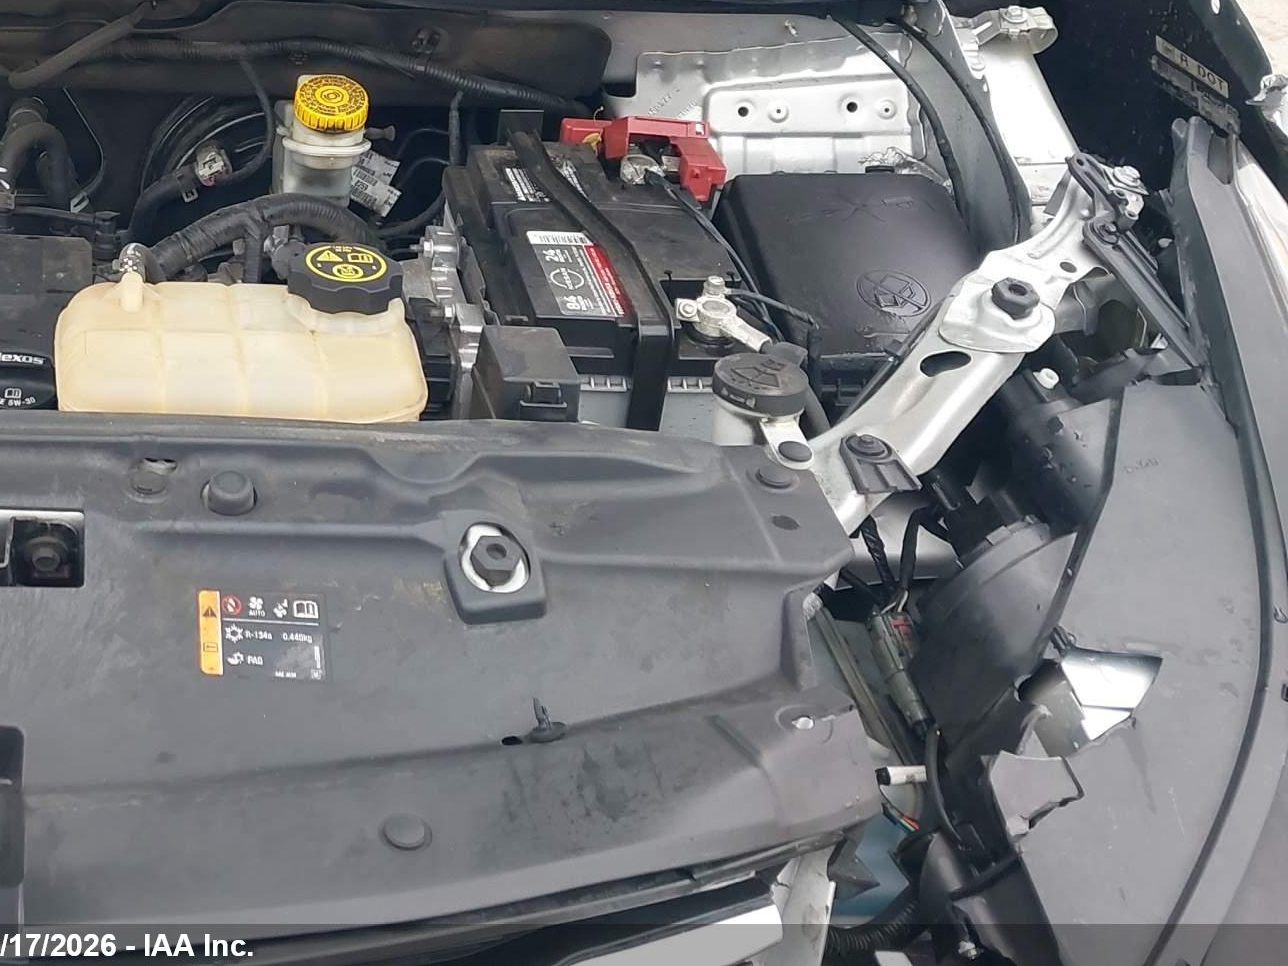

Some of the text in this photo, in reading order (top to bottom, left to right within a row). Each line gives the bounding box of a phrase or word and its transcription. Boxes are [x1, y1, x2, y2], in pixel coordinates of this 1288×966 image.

[1198, 65, 1225, 91] DOT
[8, 396, 36, 407] 5W-30
[245, 629, 273, 640] R-134a
